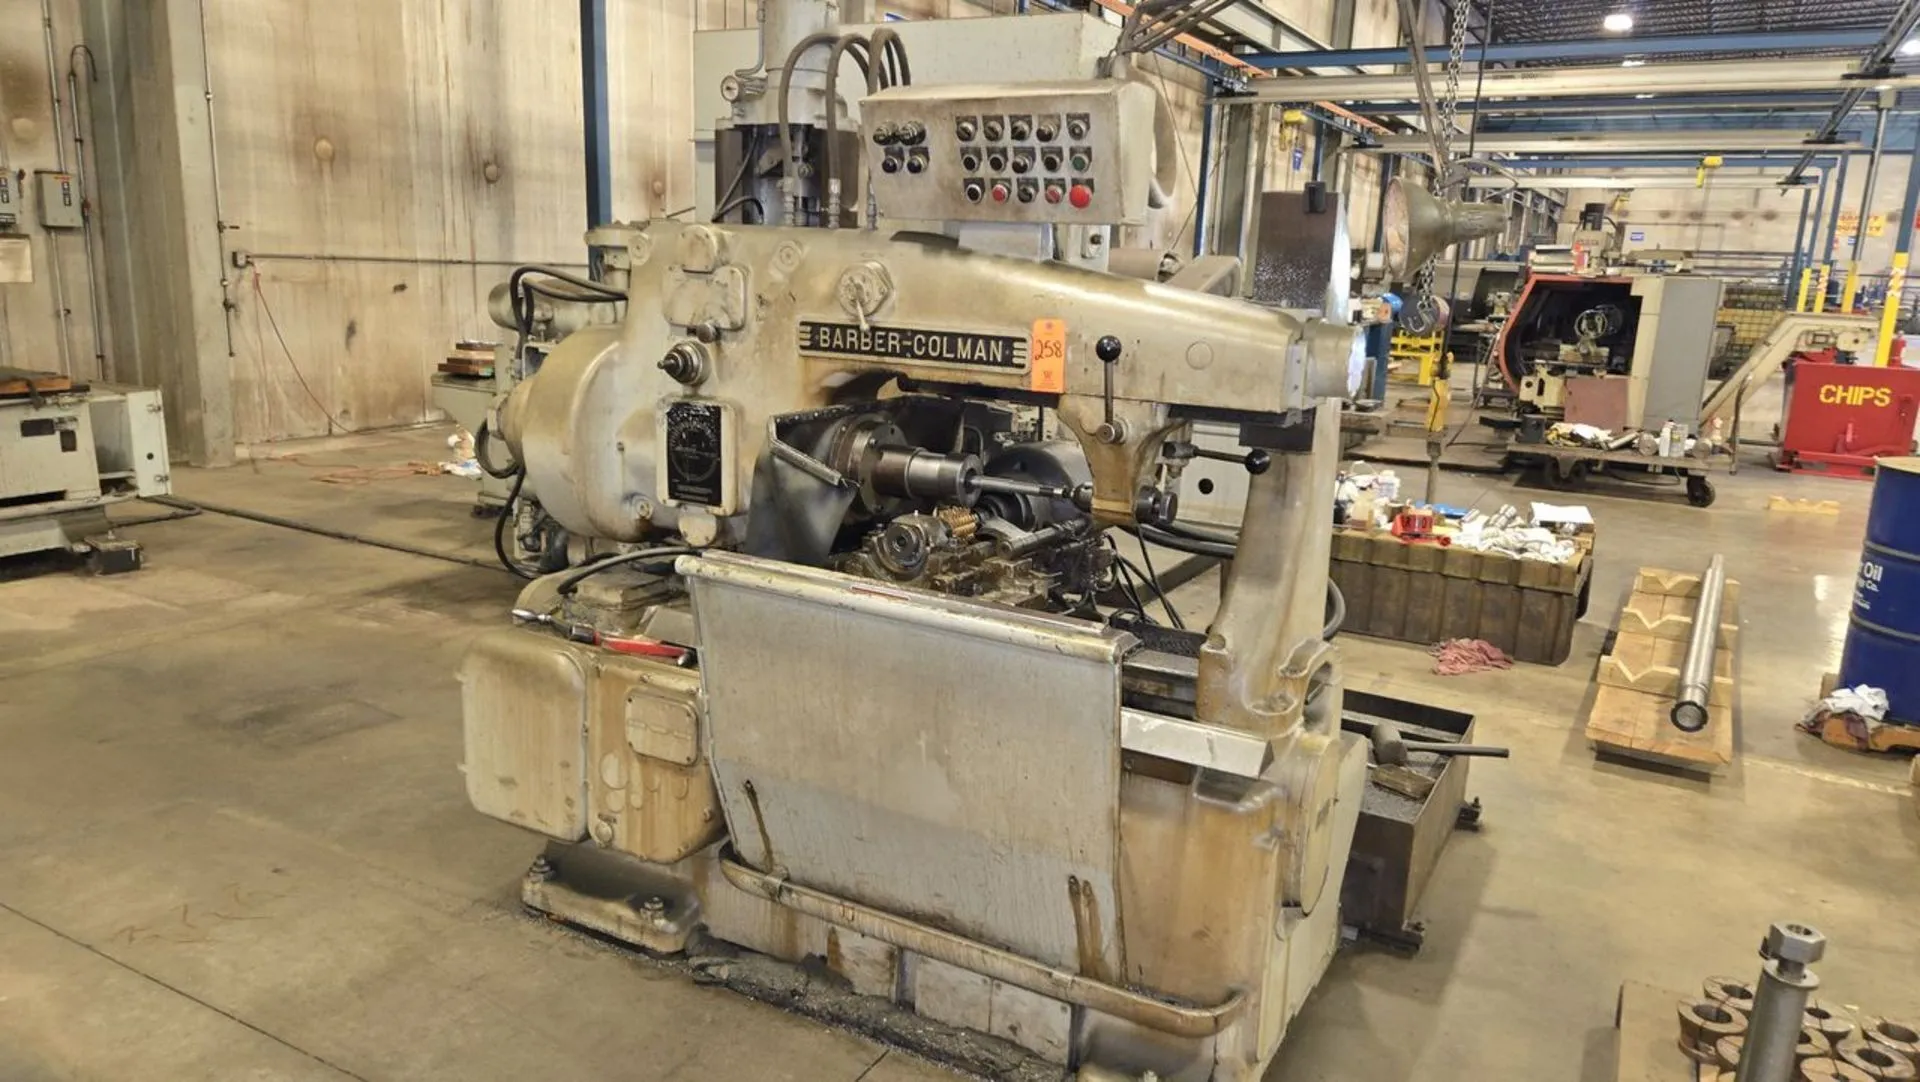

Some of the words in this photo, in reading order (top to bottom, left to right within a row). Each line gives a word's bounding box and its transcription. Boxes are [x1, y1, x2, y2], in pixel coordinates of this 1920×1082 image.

[819, 327, 1002, 362] BARBER-COLMAN
[1034, 339, 1063, 361] 258
[1819, 384, 1892, 407] CHIPS
[1864, 561, 1883, 581] Oil
